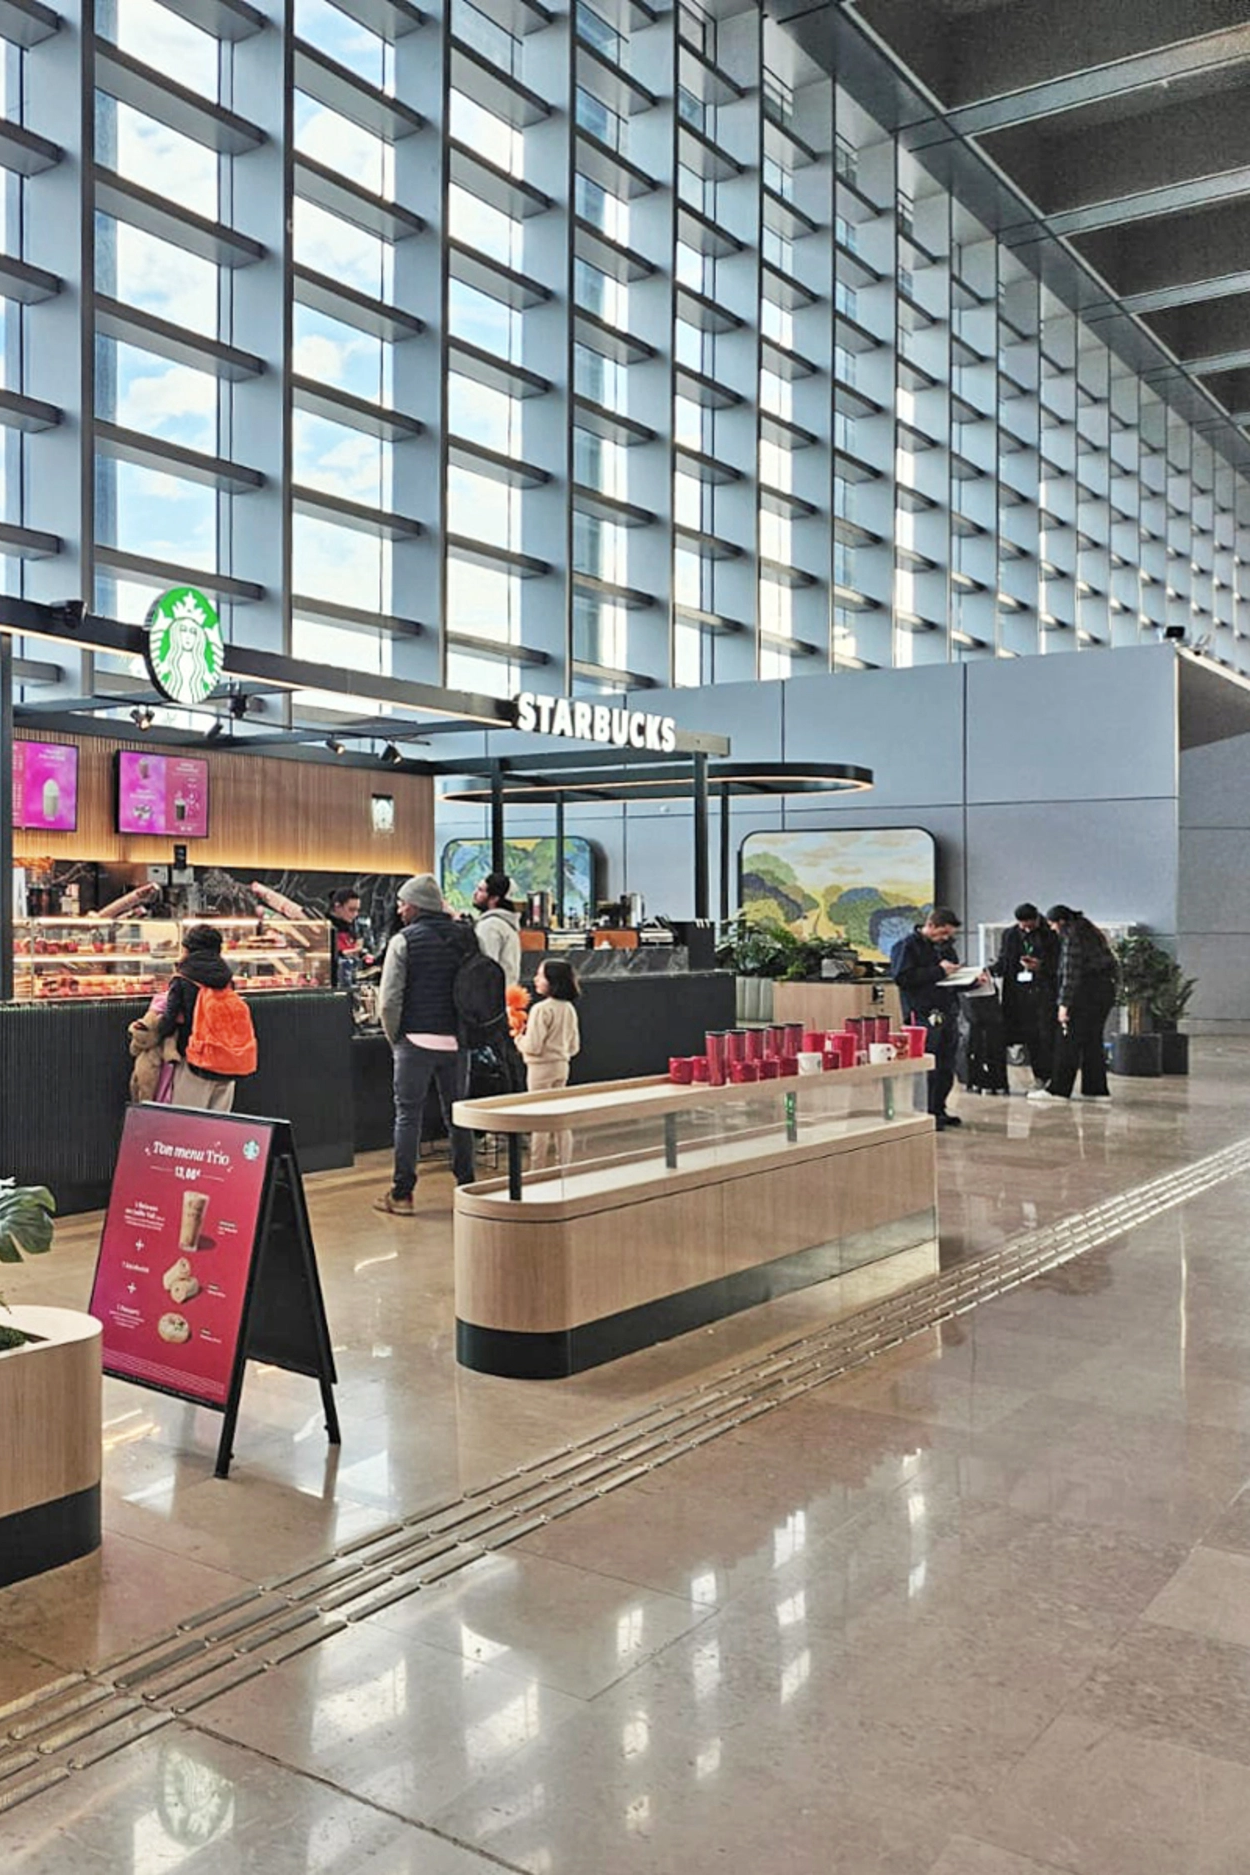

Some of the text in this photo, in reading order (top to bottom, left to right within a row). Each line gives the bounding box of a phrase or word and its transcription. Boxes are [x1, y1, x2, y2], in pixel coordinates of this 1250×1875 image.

[517, 692, 676, 752] STARBUCKS
[153, 1141, 230, 1166] Ton menu Trio
